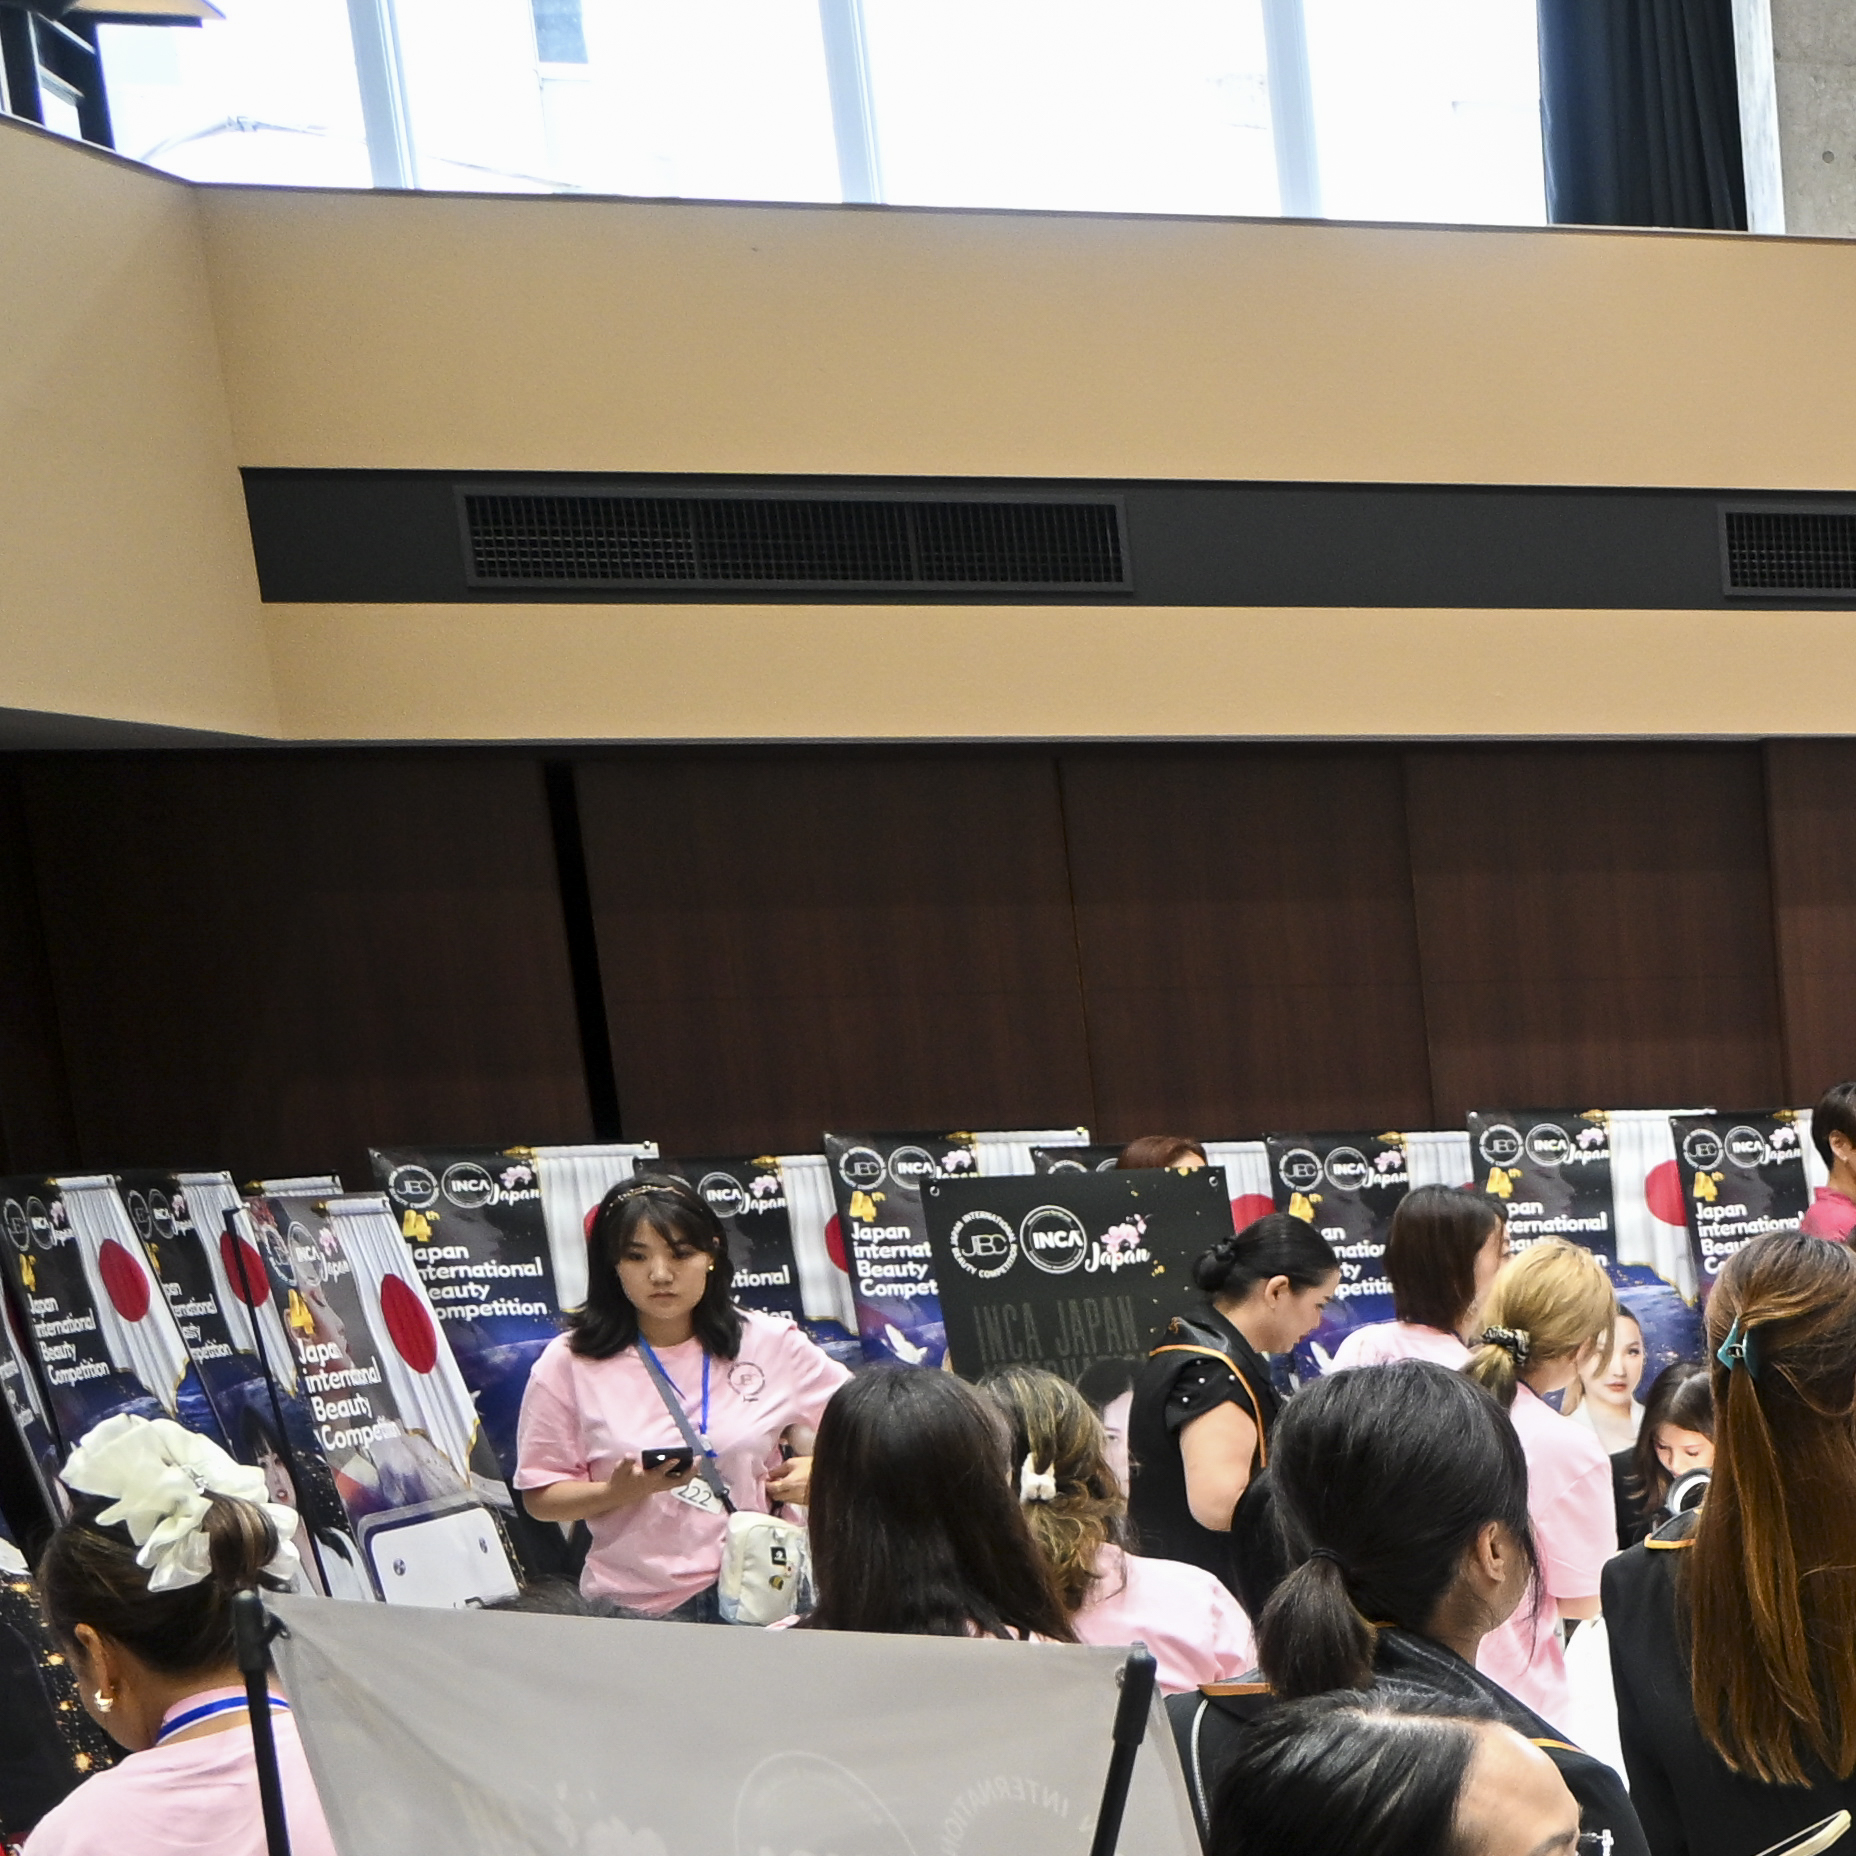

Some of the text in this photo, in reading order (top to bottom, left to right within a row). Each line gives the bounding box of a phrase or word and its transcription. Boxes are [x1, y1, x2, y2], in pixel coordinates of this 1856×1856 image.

[1534, 1139, 1567, 1151] INCA
[1564, 1144, 1610, 1165] Japan
[1732, 1140, 1763, 1153] INCA
[1759, 1144, 1802, 1165] Japan
[898, 1162, 933, 1175] INCA
[1333, 1162, 1367, 1176] INCA
[1364, 1166, 1408, 1189] Japan
[451, 1180, 491, 1192] INCA
[486, 1183, 540, 1206] Japan
[706, 1189, 741, 1201] INCA
[738, 1193, 786, 1215] Japan
[1506, 1200, 1544, 1219] pan
[1695, 1202, 1748, 1221] Japan
[1506, 1212, 1608, 1232] ernational
[851, 1222, 911, 1243] Japan
[1032, 1229, 1085, 1250] INCA
[854, 1241, 932, 1260] internat
[1701, 1237, 1750, 1257] Beau
[1085, 1242, 1151, 1273] Japan
[417, 1256, 543, 1280] nternational
[857, 1260, 928, 1280] Beauty
[428, 1281, 491, 1300] eauty
[860, 1279, 938, 1299] Compet
[434, 1298, 548, 1321] ompetition
[974, 1296, 1140, 1360] INCA JAPAN
[310, 1393, 373, 1421] Beauty
